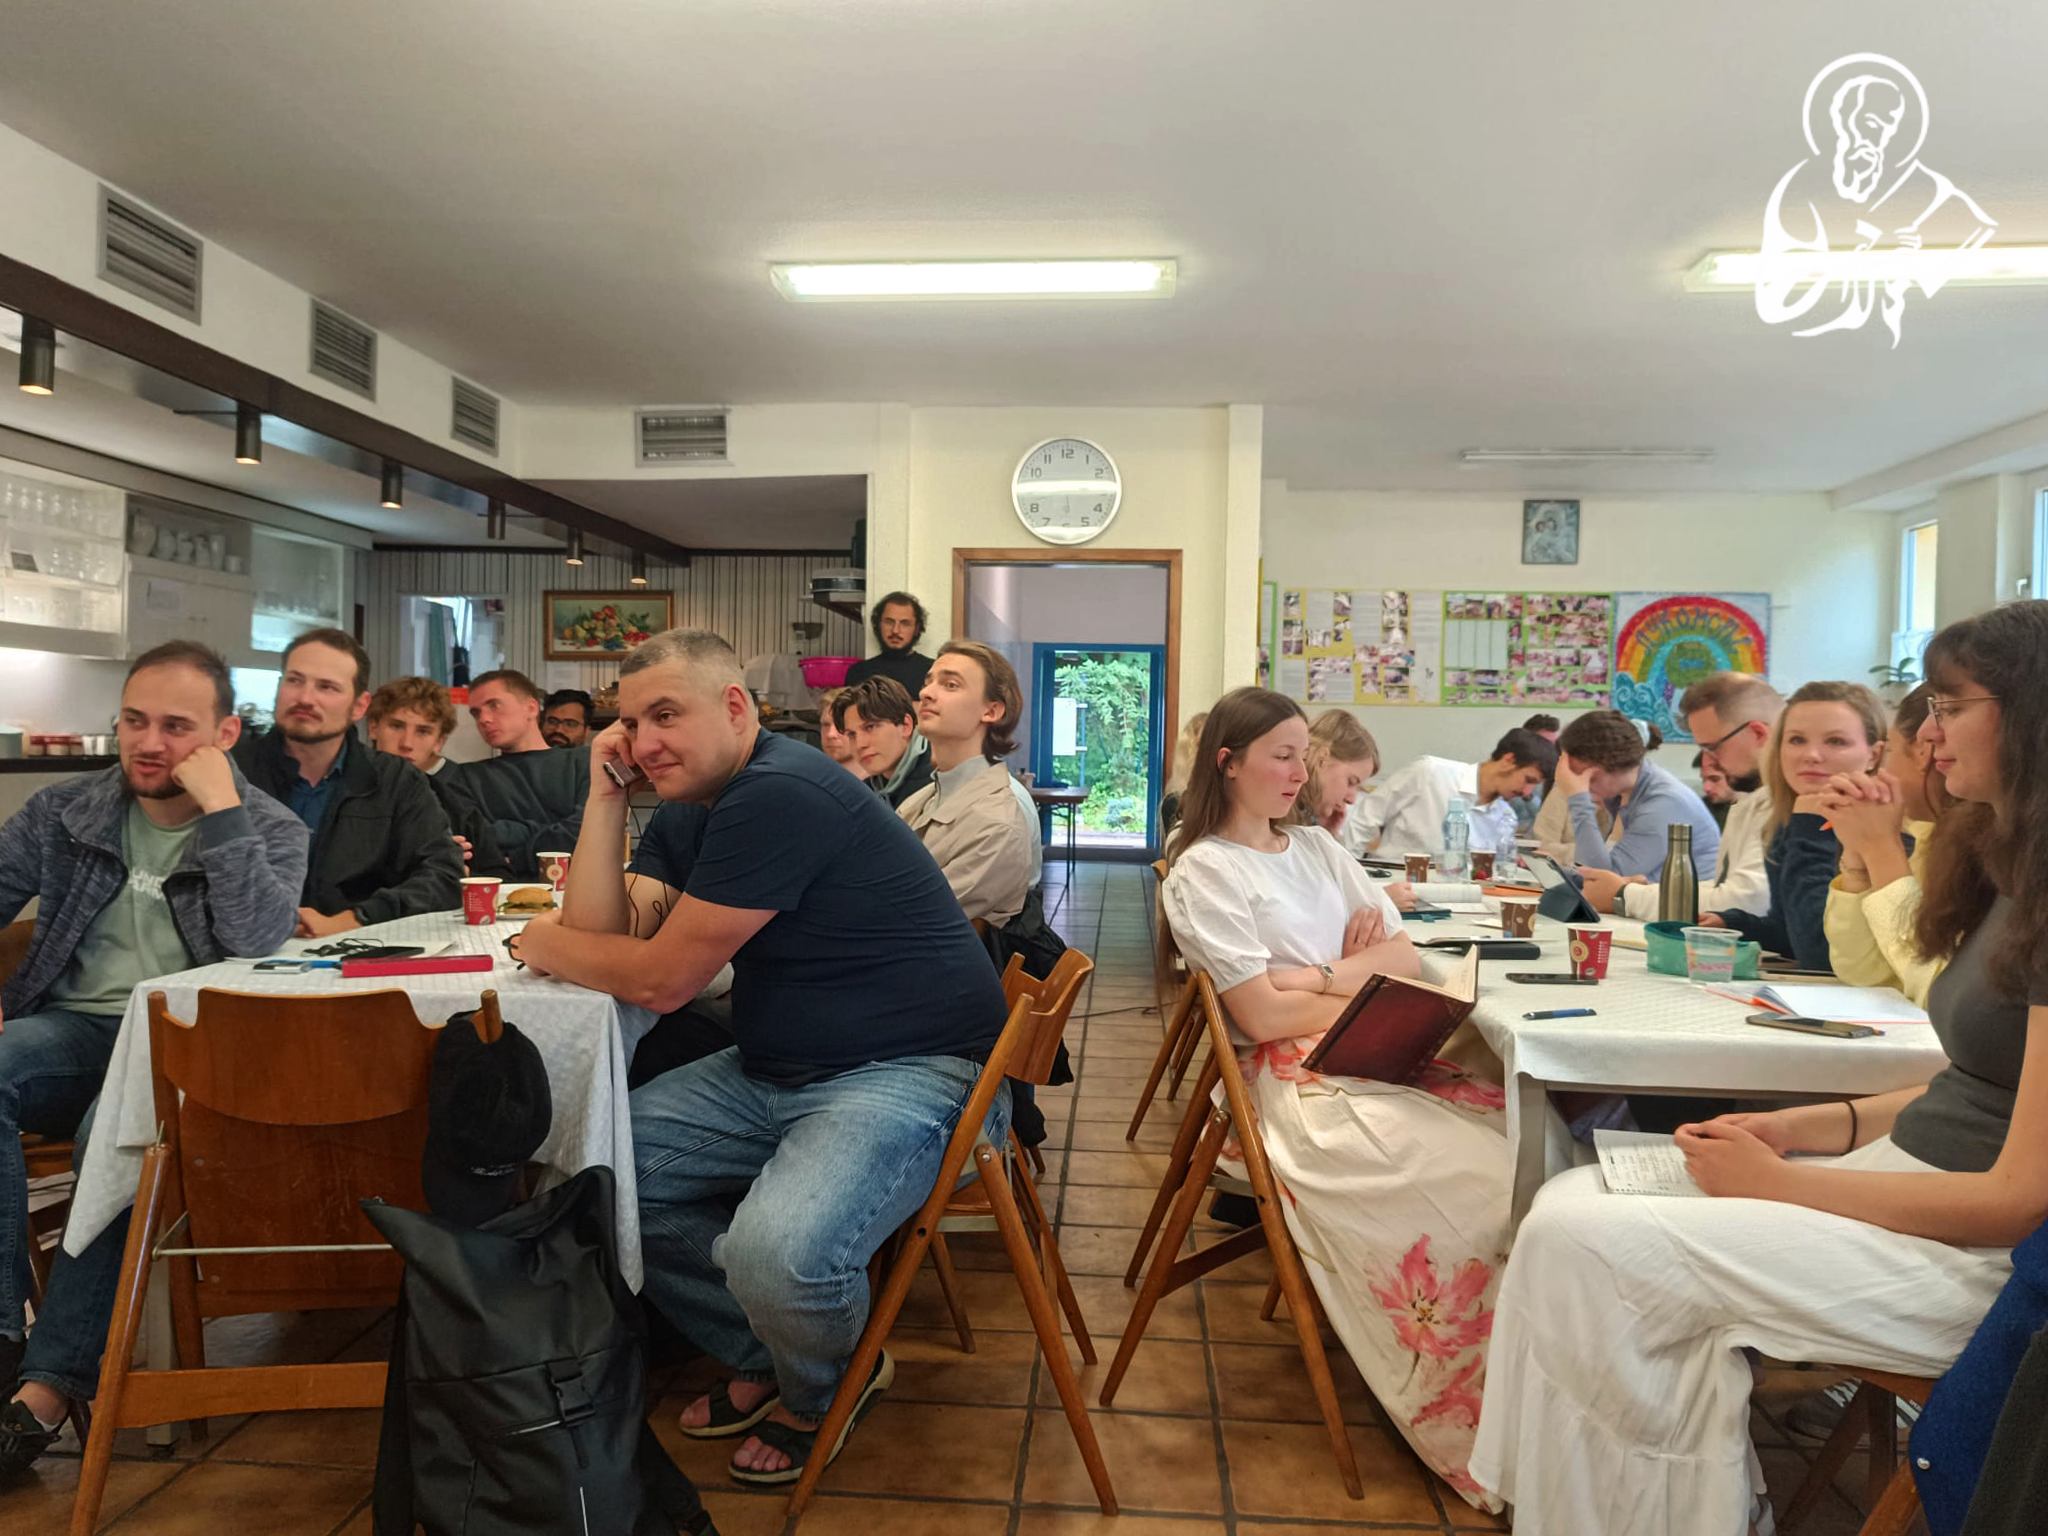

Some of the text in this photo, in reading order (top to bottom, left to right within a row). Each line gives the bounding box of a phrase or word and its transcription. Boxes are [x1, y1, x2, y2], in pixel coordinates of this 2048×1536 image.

[1061, 448, 1074, 459] 12
[1044, 454, 1052, 465] 11
[1030, 467, 1042, 479] 10
[1094, 468, 1104, 479] 2
[1030, 503, 1039, 513] 8
[1093, 503, 1103, 513] 4
[1042, 517, 1051, 527] 7
[1081, 516, 1090, 527] 5
